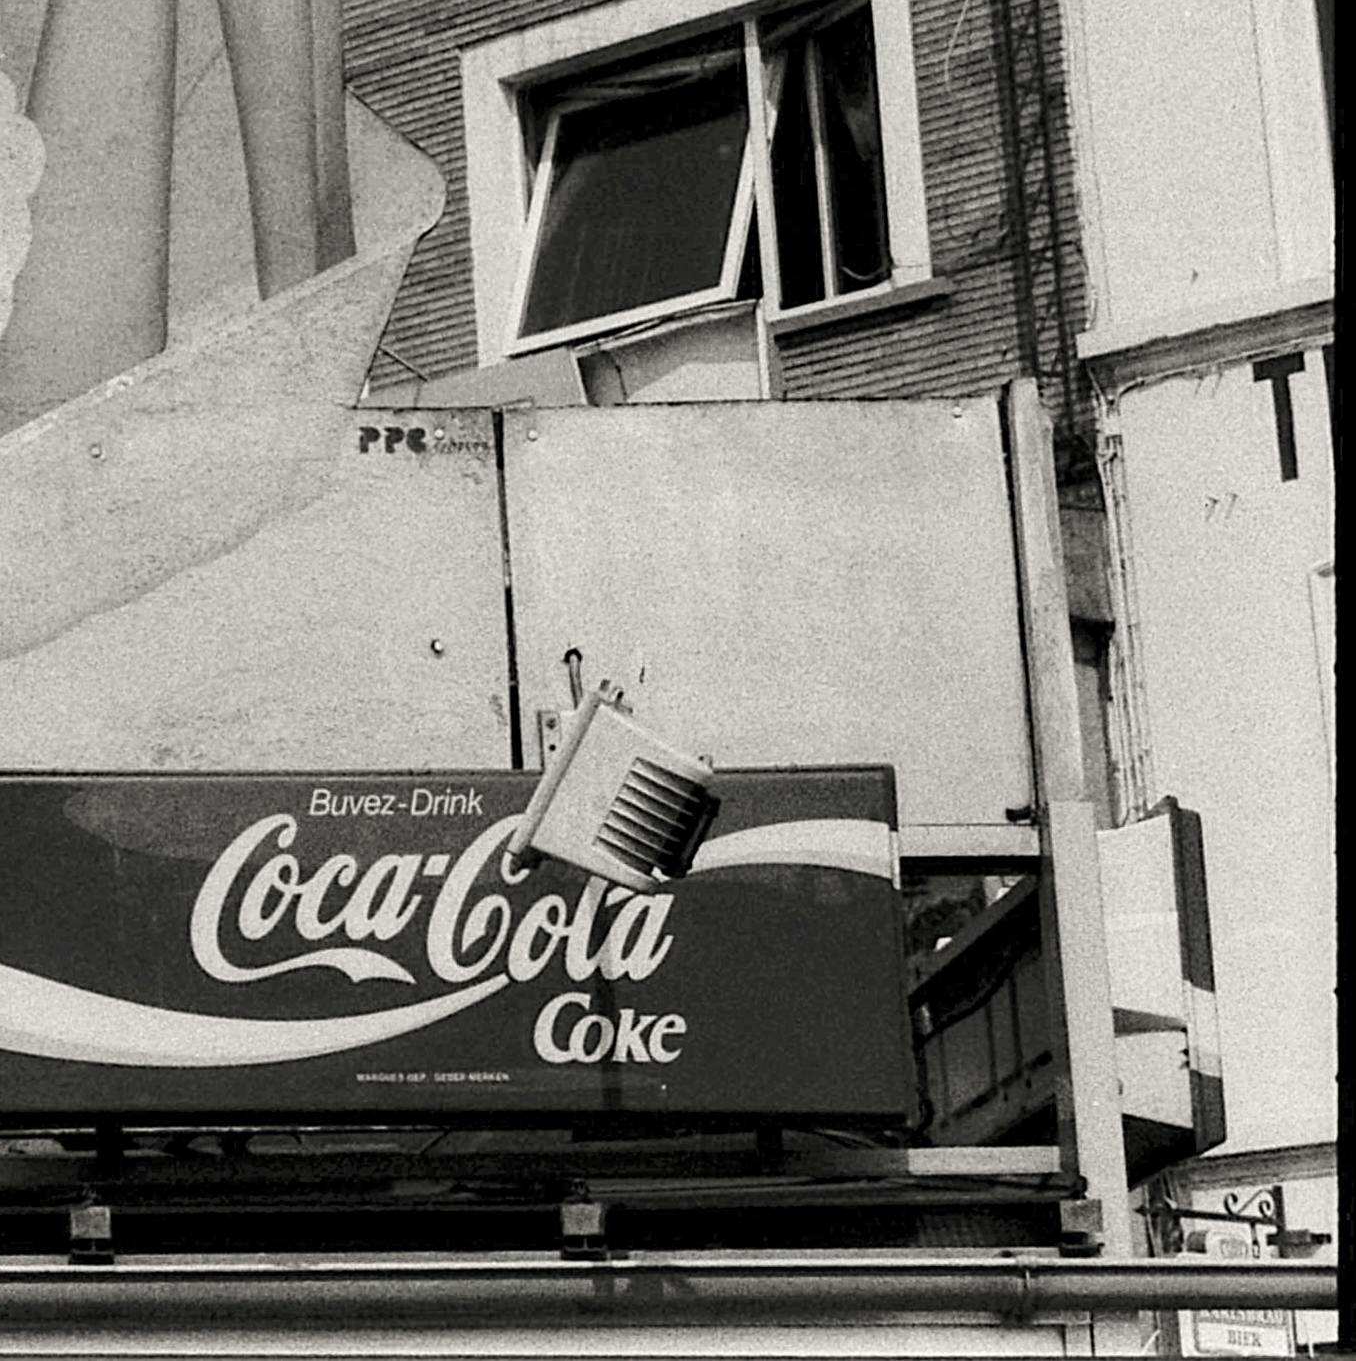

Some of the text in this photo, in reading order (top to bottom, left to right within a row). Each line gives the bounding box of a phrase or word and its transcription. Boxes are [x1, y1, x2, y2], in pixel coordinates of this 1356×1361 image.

[309, 787, 483, 816] Buvez-Drink
[190, 812, 675, 984] Coca-Cola
[534, 992, 687, 1064] Coke
